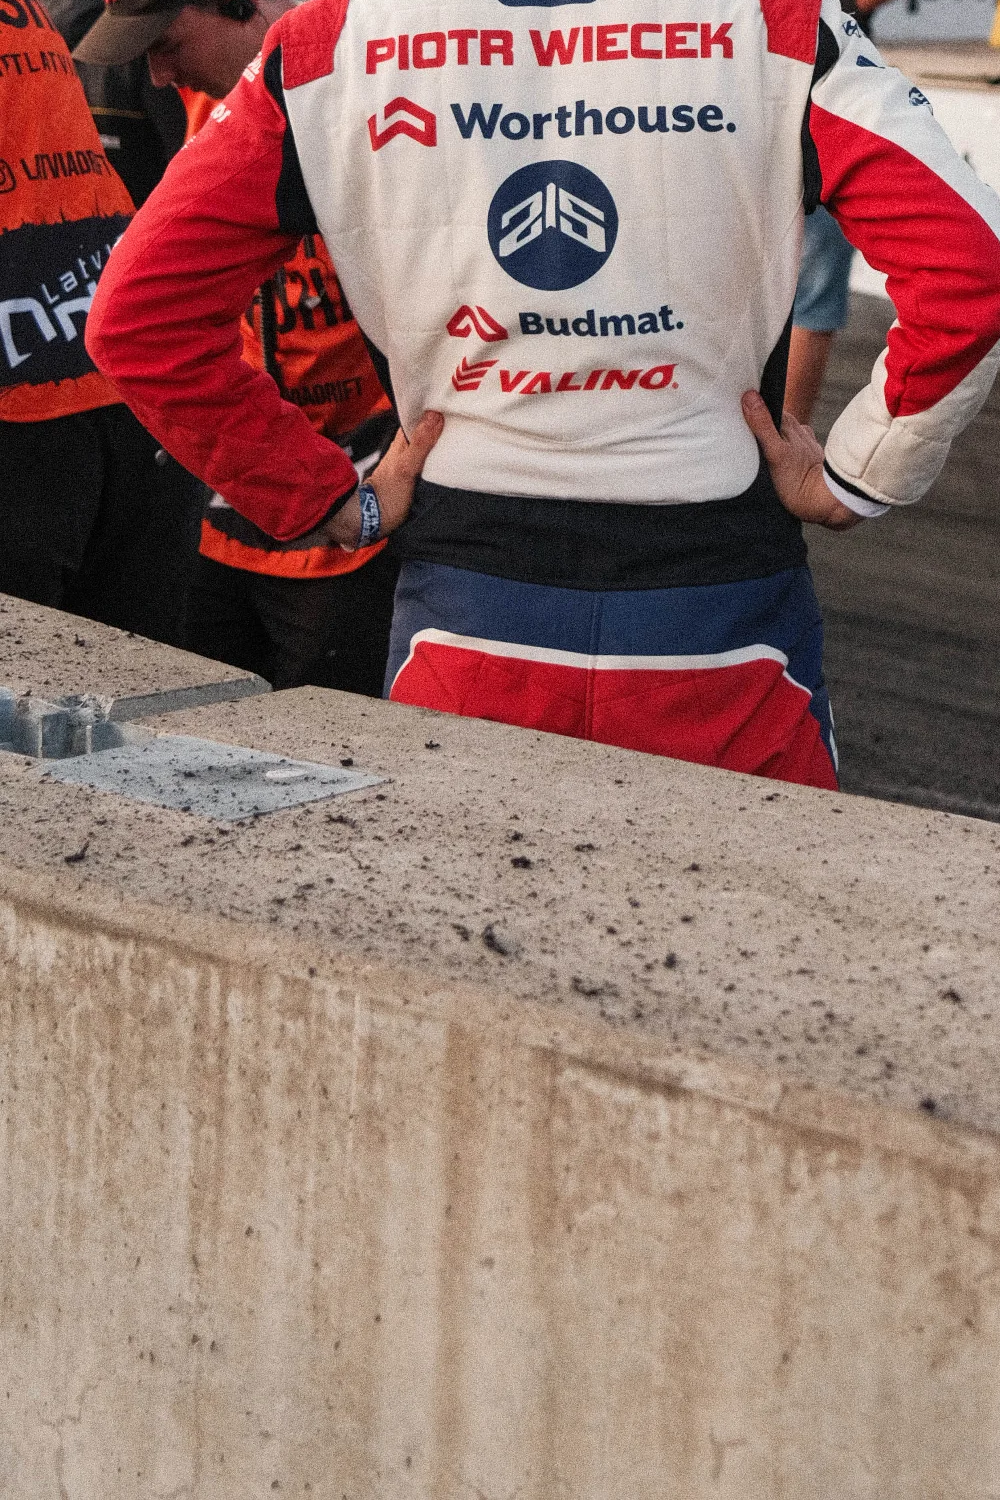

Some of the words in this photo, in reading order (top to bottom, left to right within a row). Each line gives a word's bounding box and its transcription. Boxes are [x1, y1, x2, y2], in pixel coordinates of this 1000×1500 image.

[365, 28, 514, 75] PIOTR
[528, 22, 734, 67] WIECEK
[450, 99, 737, 140] Worthouse.
[518, 304, 684, 337] Budmat.
